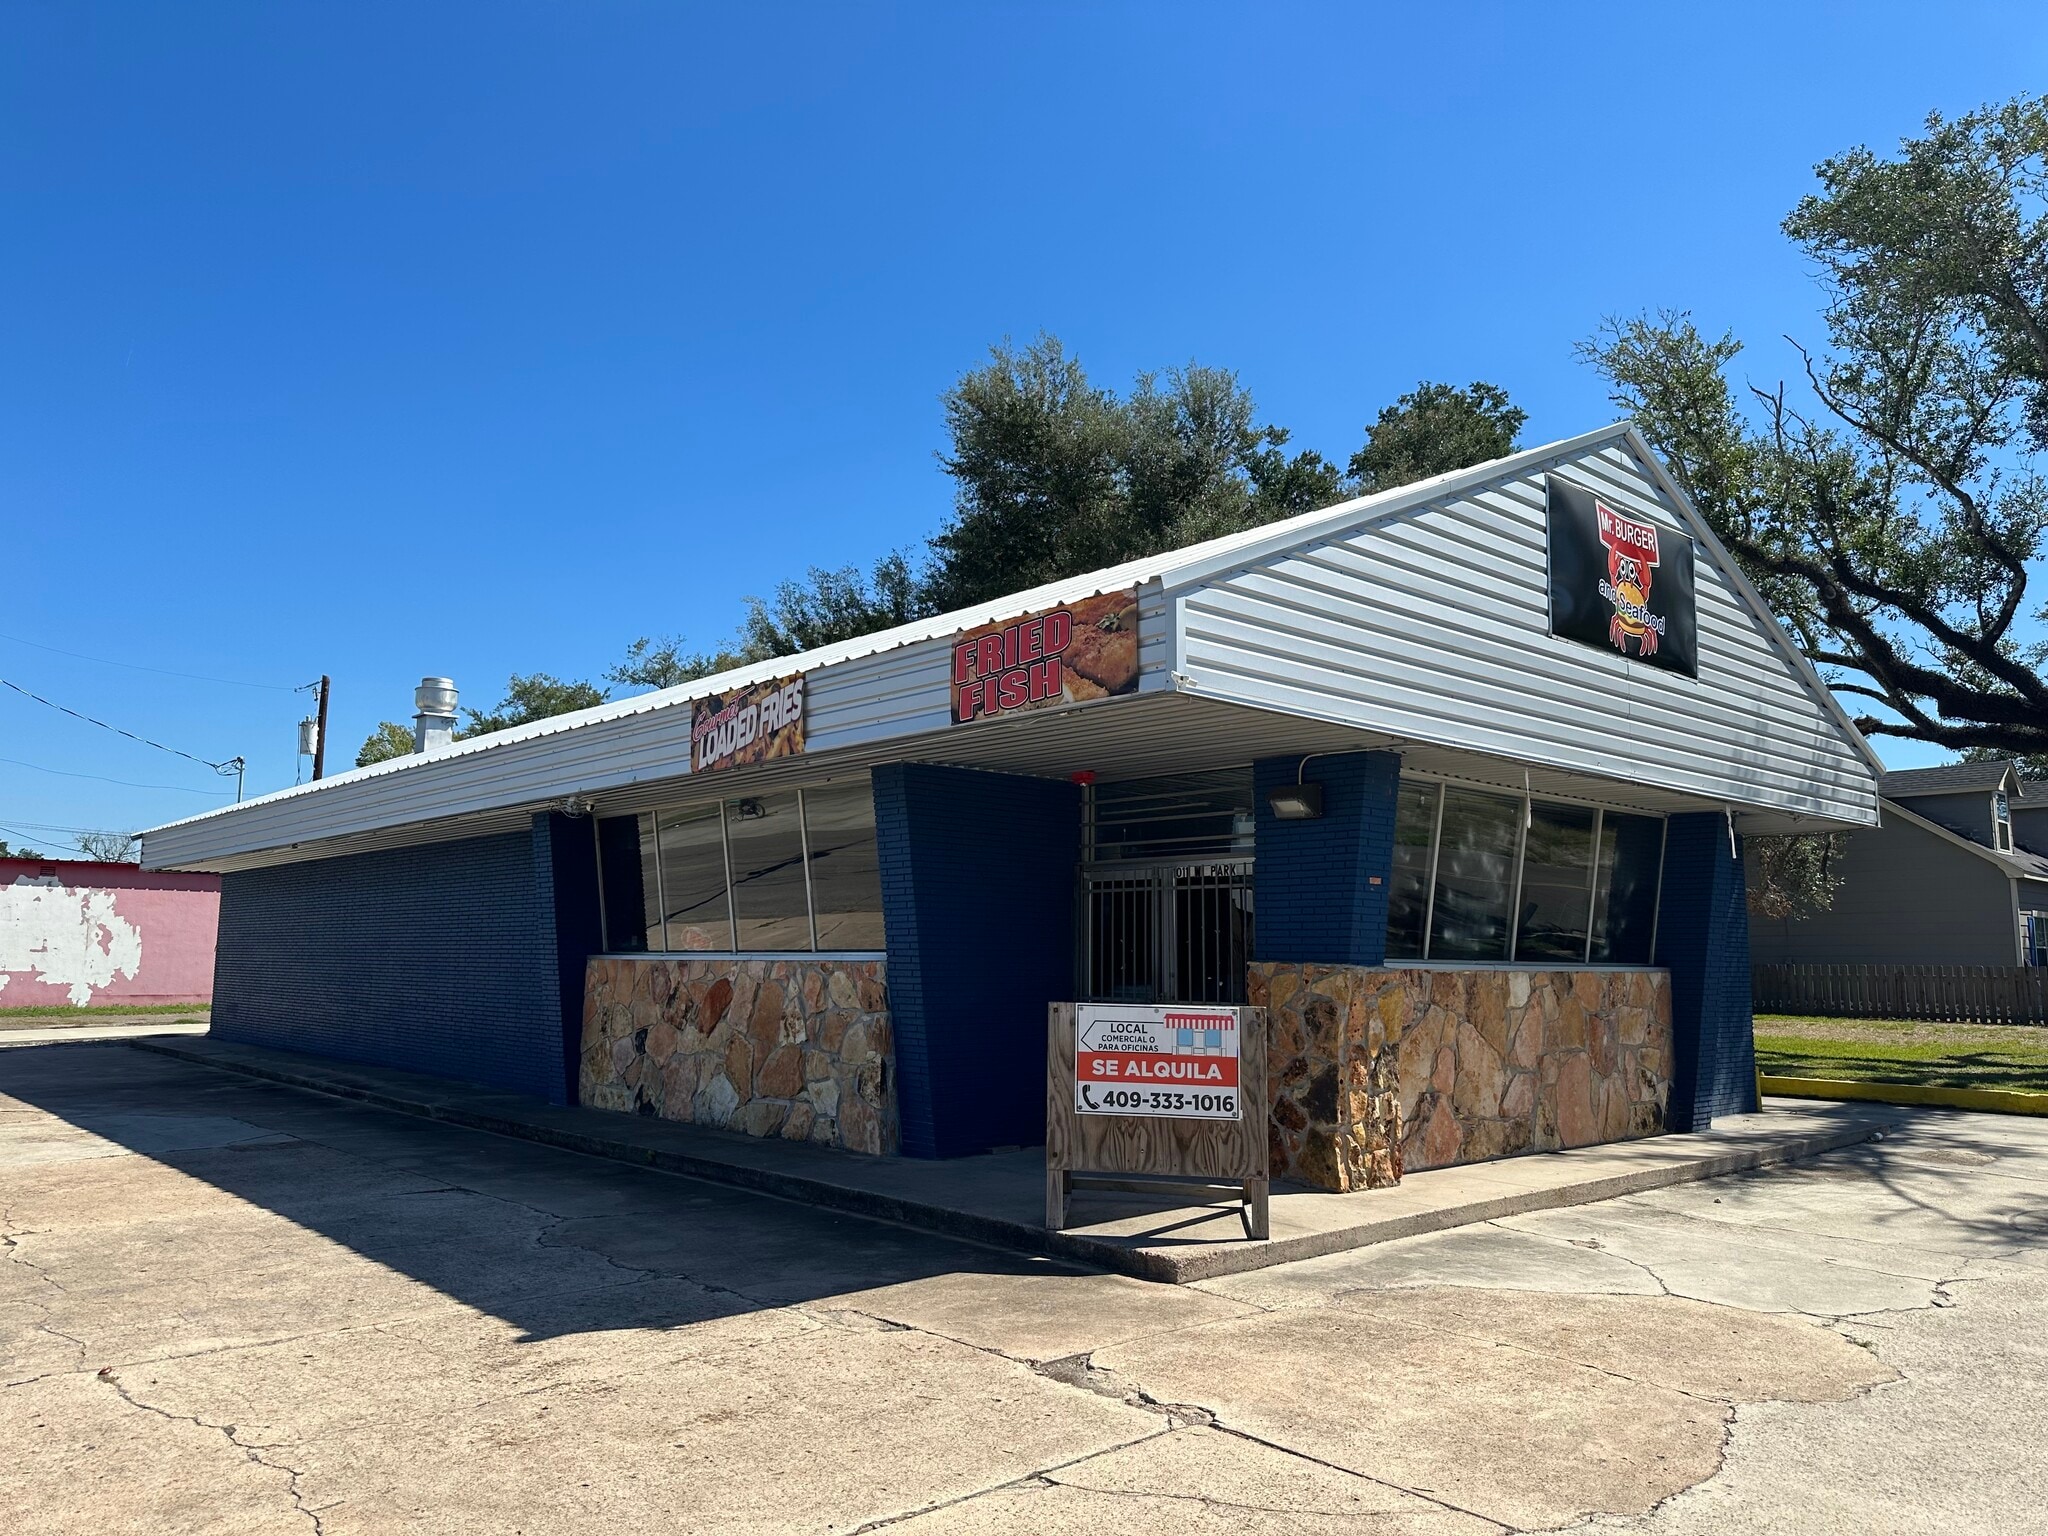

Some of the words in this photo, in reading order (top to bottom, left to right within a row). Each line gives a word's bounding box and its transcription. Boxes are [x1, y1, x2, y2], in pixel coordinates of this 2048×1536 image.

[1600, 511, 1614, 535] Mr.
[1615, 518, 1655, 552] BURGER
[1619, 591, 1666, 636] Seafood
[954, 610, 1072, 685] FRIED
[958, 656, 1063, 722] FISH
[693, 686, 755, 742] Gourmet
[698, 704, 758, 771] LOADED
[758, 678, 804, 738] FRIES
[1210, 864, 1236, 876] PARK
[1101, 1034, 1147, 1043] COMERCIAL
[1110, 1023, 1148, 1034] LOCAL
[1098, 1043, 1119, 1051] PARA
[1121, 1044, 1159, 1052] OFICINAS
[1092, 1059, 1119, 1076] SE
[1124, 1060, 1223, 1080] ALQUILA
[1103, 1090, 1235, 1112] 409-333-1016
